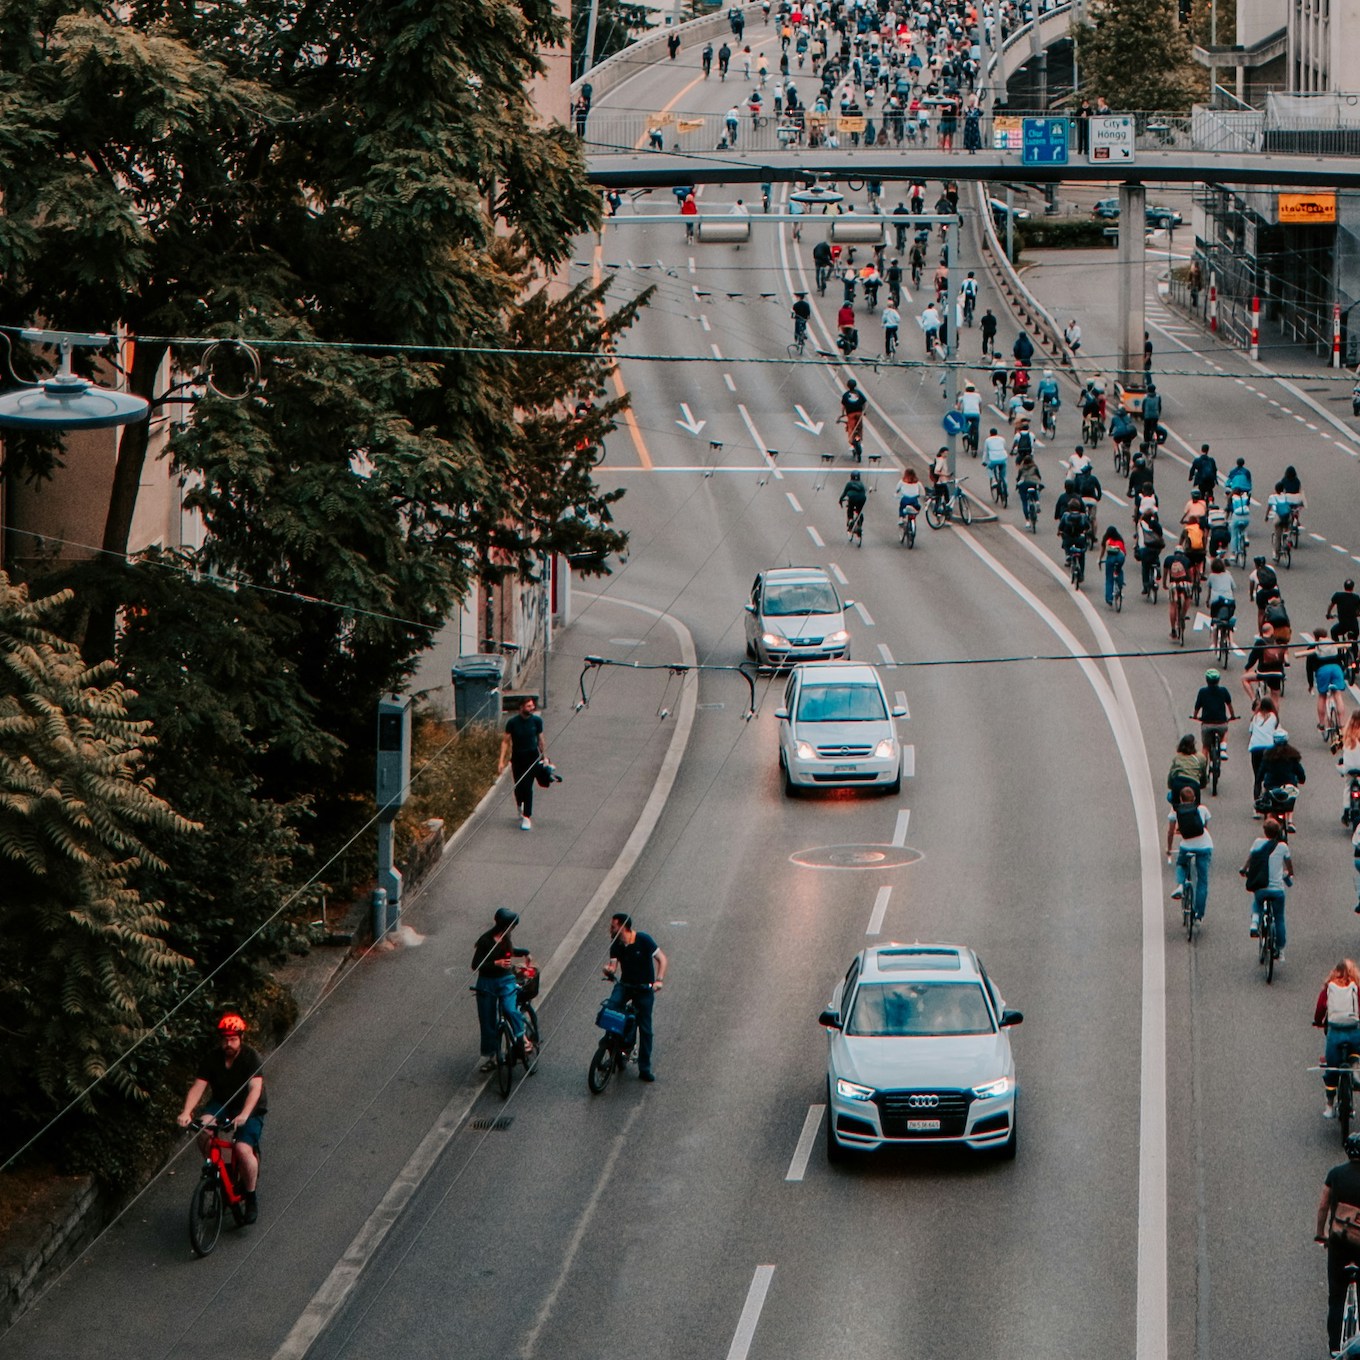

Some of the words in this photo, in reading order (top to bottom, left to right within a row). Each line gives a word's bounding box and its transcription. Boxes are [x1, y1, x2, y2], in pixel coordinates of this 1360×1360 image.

[1103, 119, 1120, 129] City
[1028, 129, 1043, 138] Chur
[1097, 130, 1127, 141] Höngg
